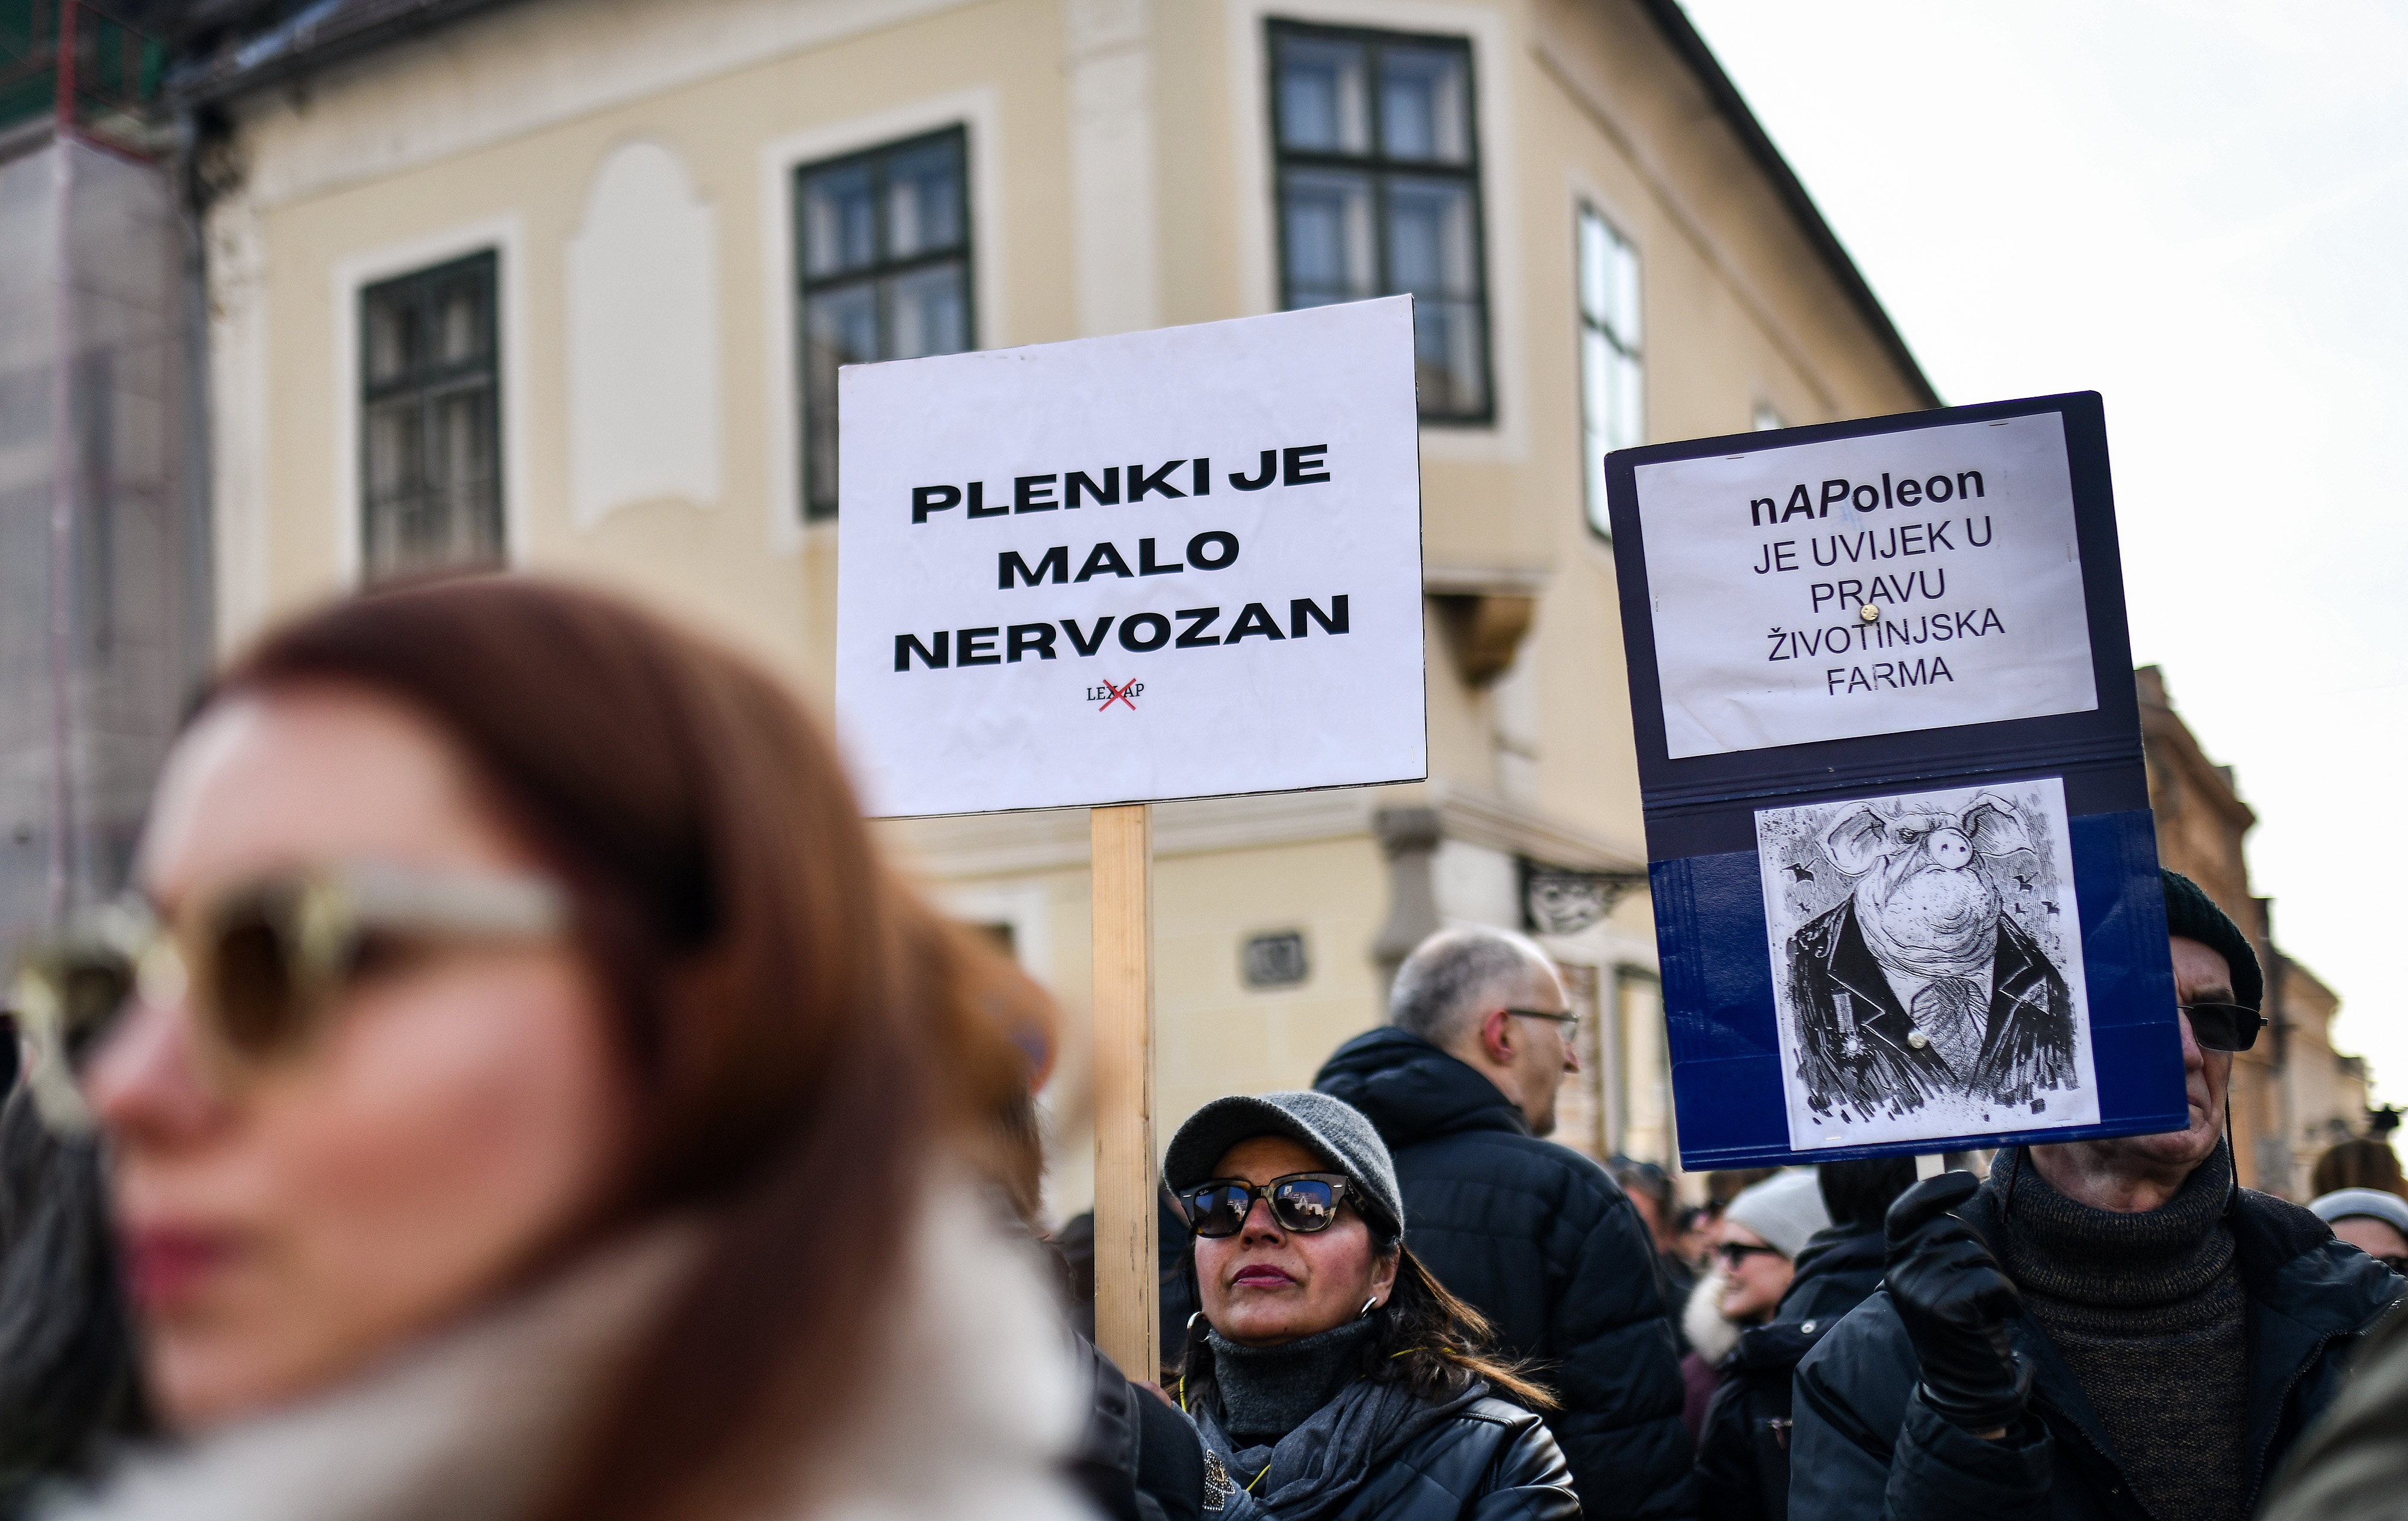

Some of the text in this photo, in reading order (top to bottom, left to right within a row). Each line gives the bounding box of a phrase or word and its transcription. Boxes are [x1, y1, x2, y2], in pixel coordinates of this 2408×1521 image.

[911, 444, 1331, 524] PLENKI JE
[1750, 470, 1985, 527] nAPoleon
[998, 530, 1240, 590] MALO
[1754, 515, 1992, 575] JE UVIJEK U
[1810, 568, 1945, 614] PRAVU
[894, 594, 1350, 672] NERVOZAN
[1767, 607, 2006, 661] ŽIVOTINJSKA
[1123, 683, 1145, 698] AP
[1826, 656, 1954, 696] FARMA
